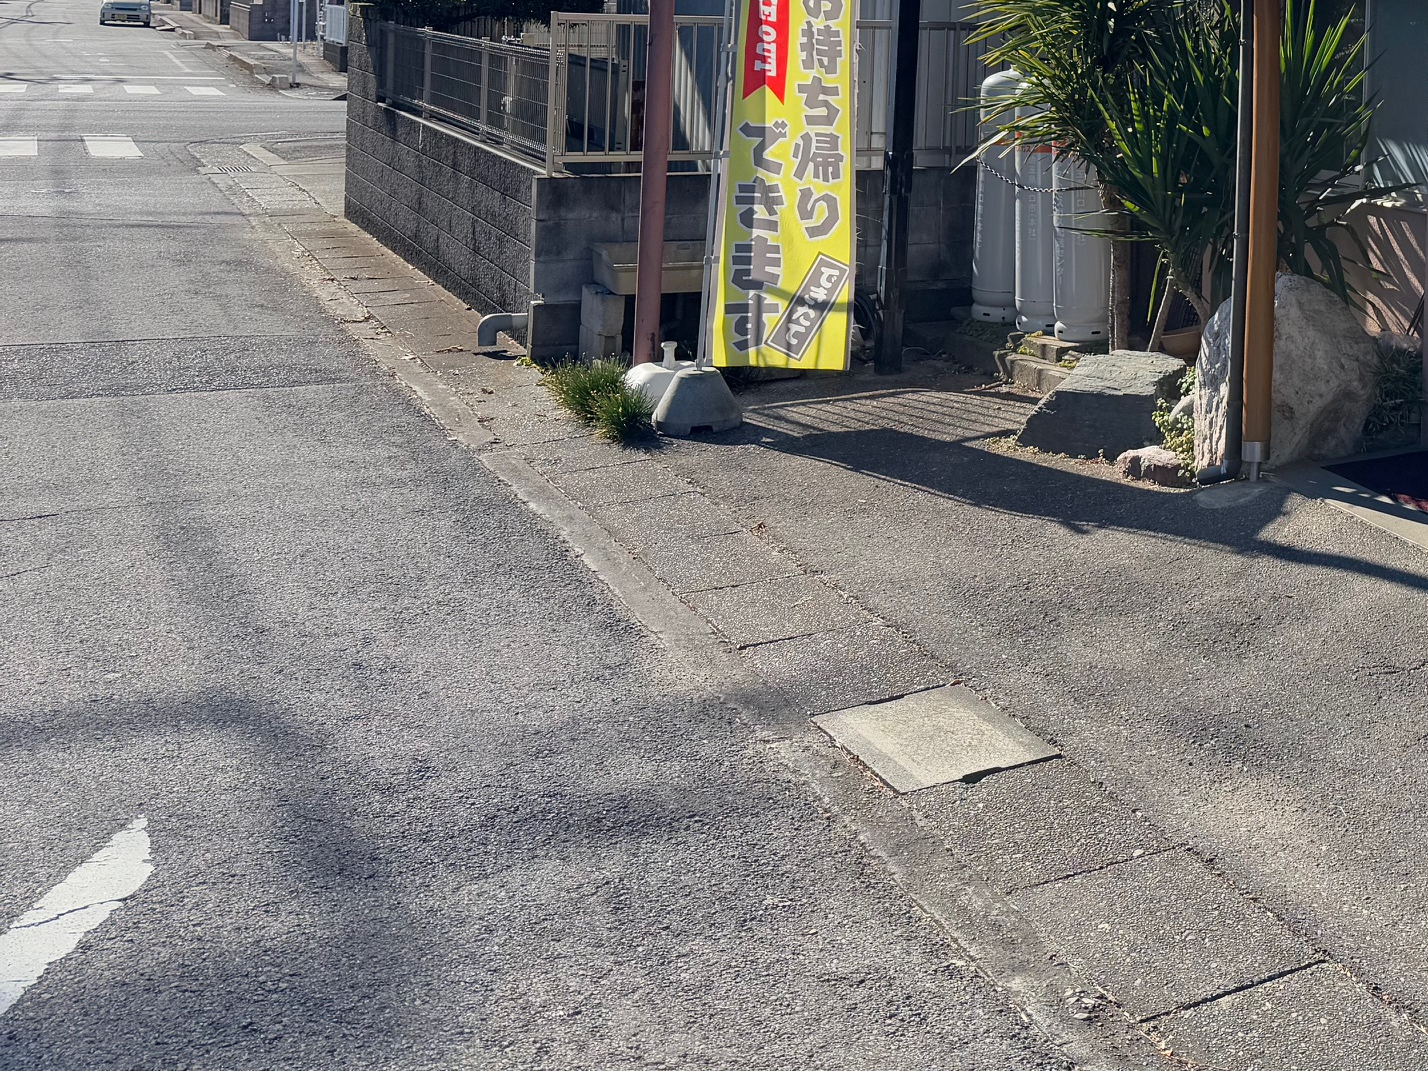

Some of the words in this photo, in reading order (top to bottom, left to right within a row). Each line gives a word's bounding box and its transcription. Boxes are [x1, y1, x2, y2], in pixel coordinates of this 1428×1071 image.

[754, 24, 777, 77] OUT
[724, 120, 788, 352] できます
[785, 266, 840, 345] できたて
